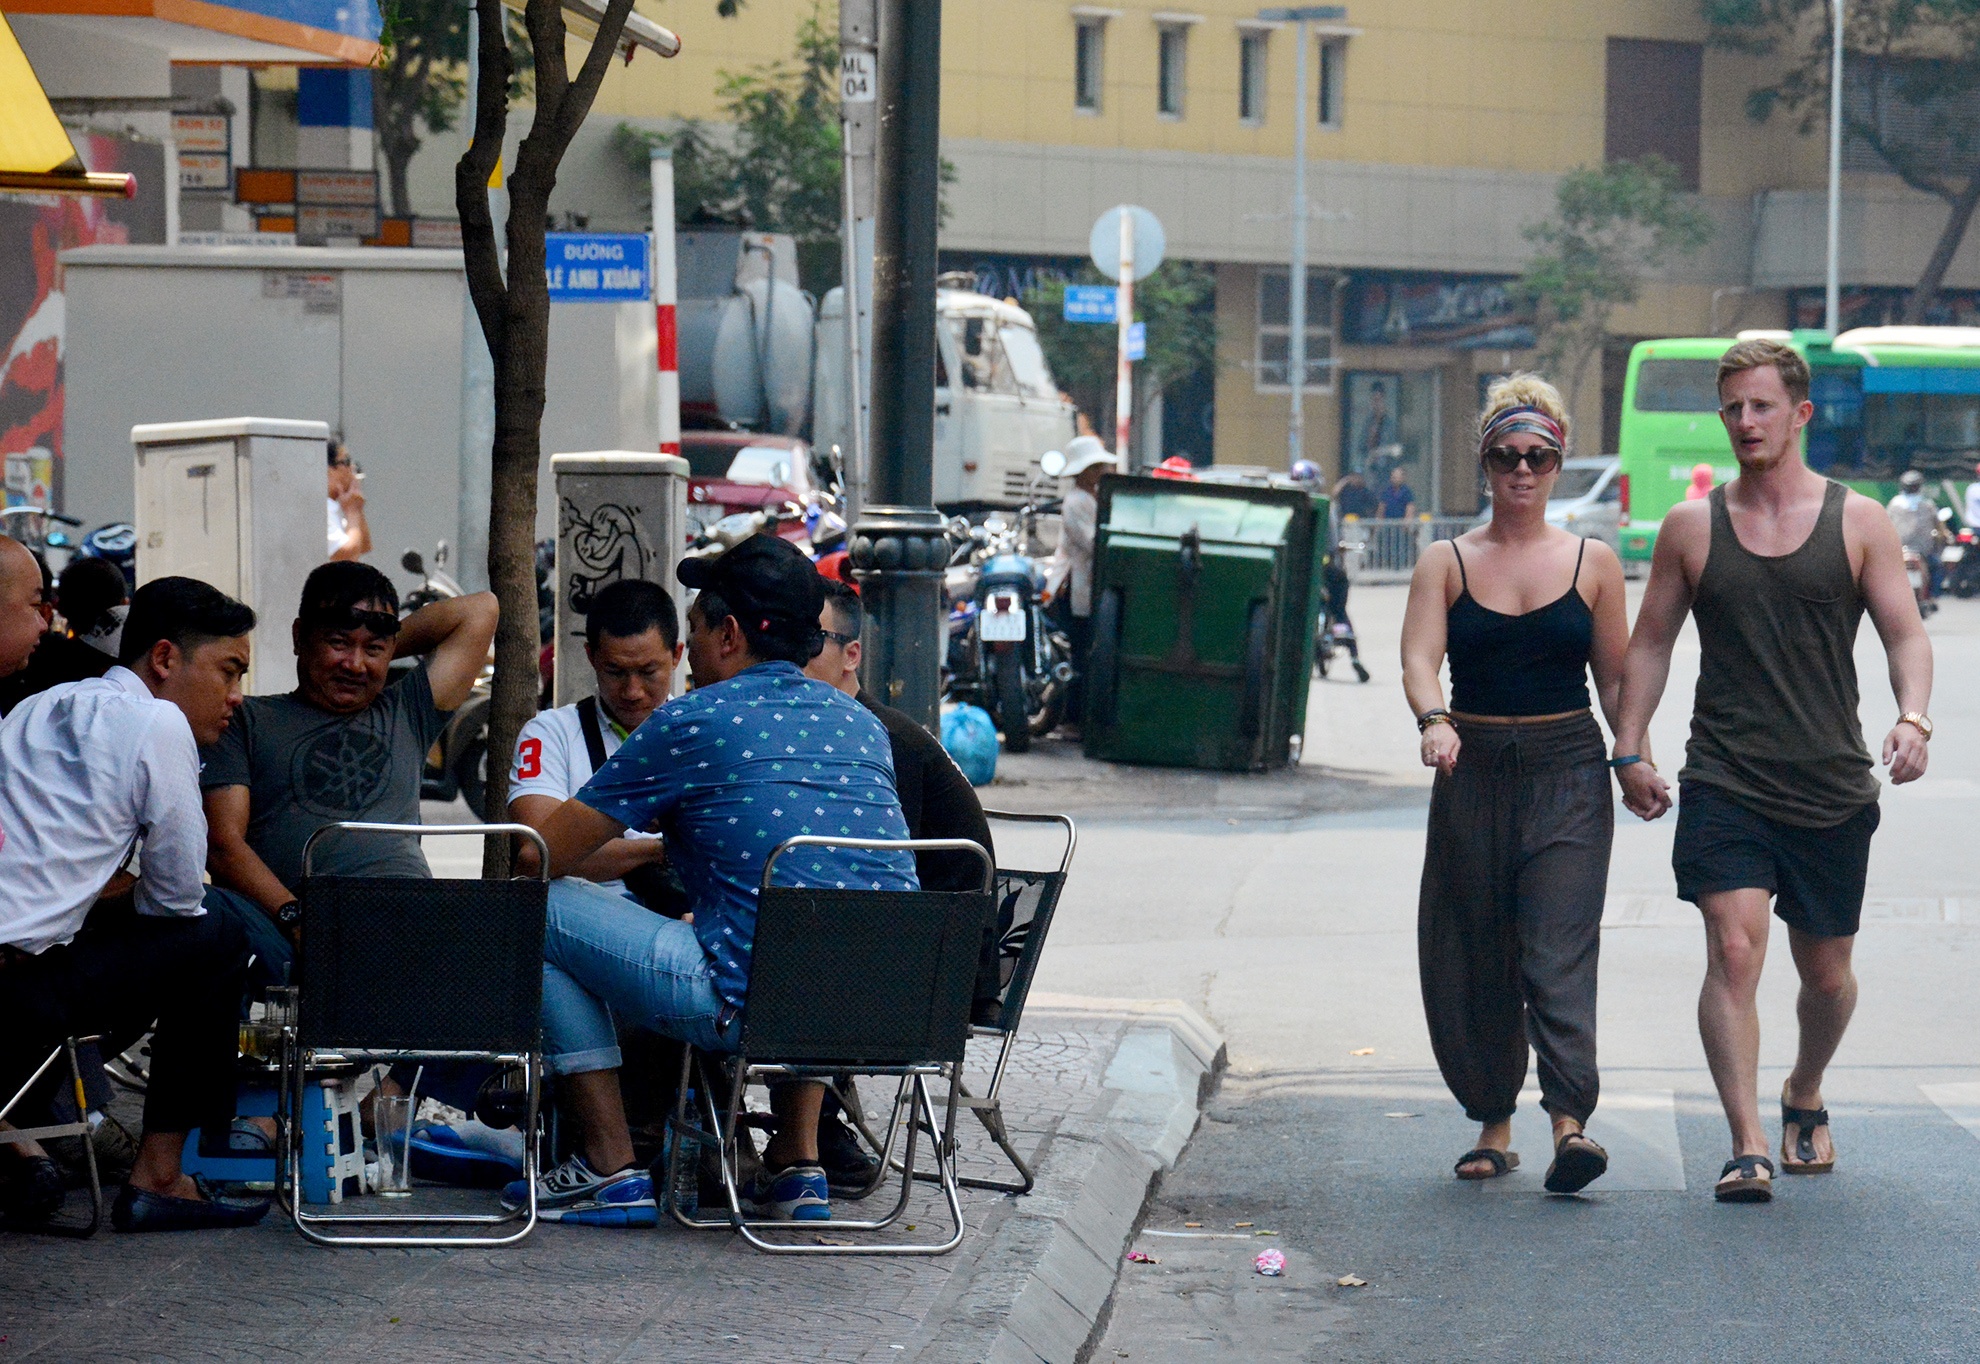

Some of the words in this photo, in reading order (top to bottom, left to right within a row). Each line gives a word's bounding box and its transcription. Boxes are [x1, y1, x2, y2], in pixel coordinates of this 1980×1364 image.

[842, 57, 867, 73] ML
[846, 78, 867, 96] 04
[568, 268, 599, 290] ANH
[517, 737, 542, 780] 3
